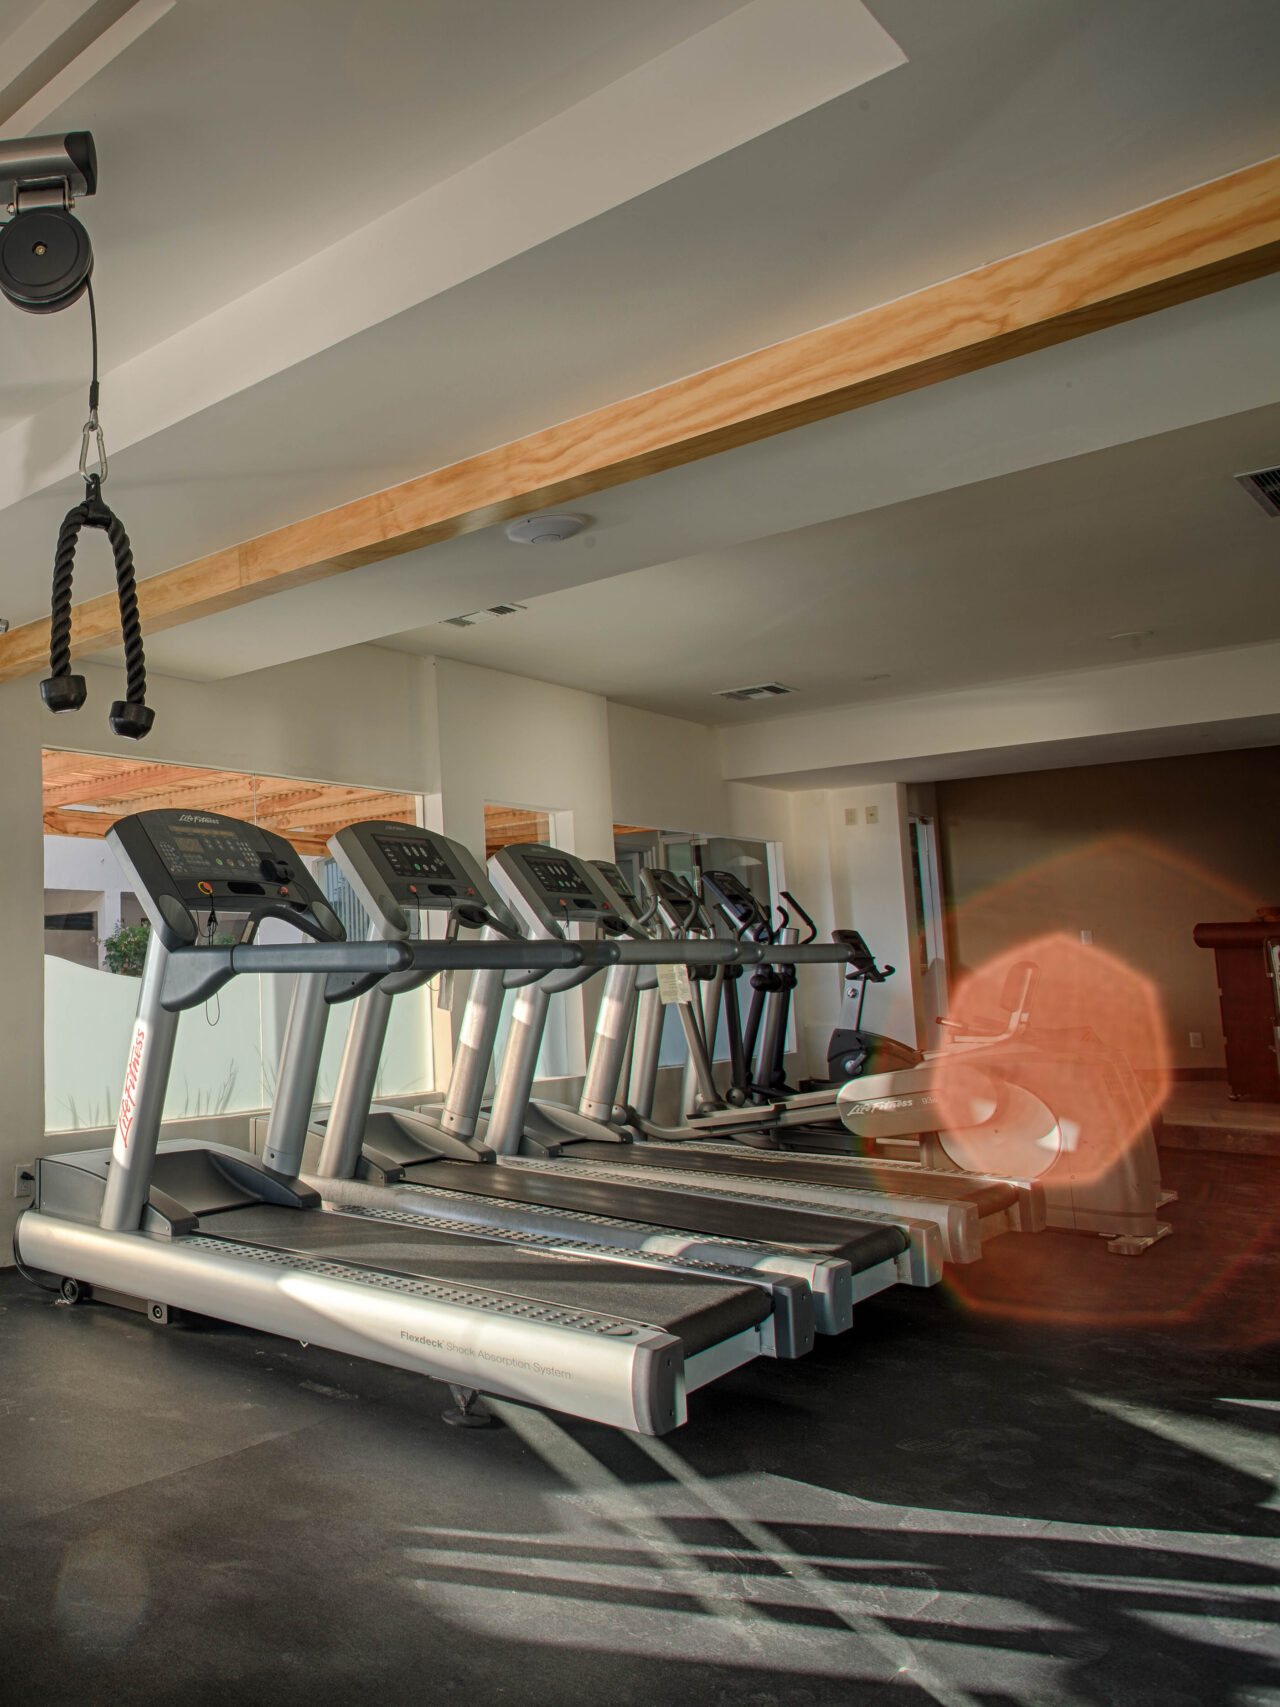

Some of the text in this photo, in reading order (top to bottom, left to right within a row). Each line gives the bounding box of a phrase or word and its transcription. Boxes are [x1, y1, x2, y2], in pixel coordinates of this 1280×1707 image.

[399, 1329, 572, 1380] Flexdeck Shock Absorption System
